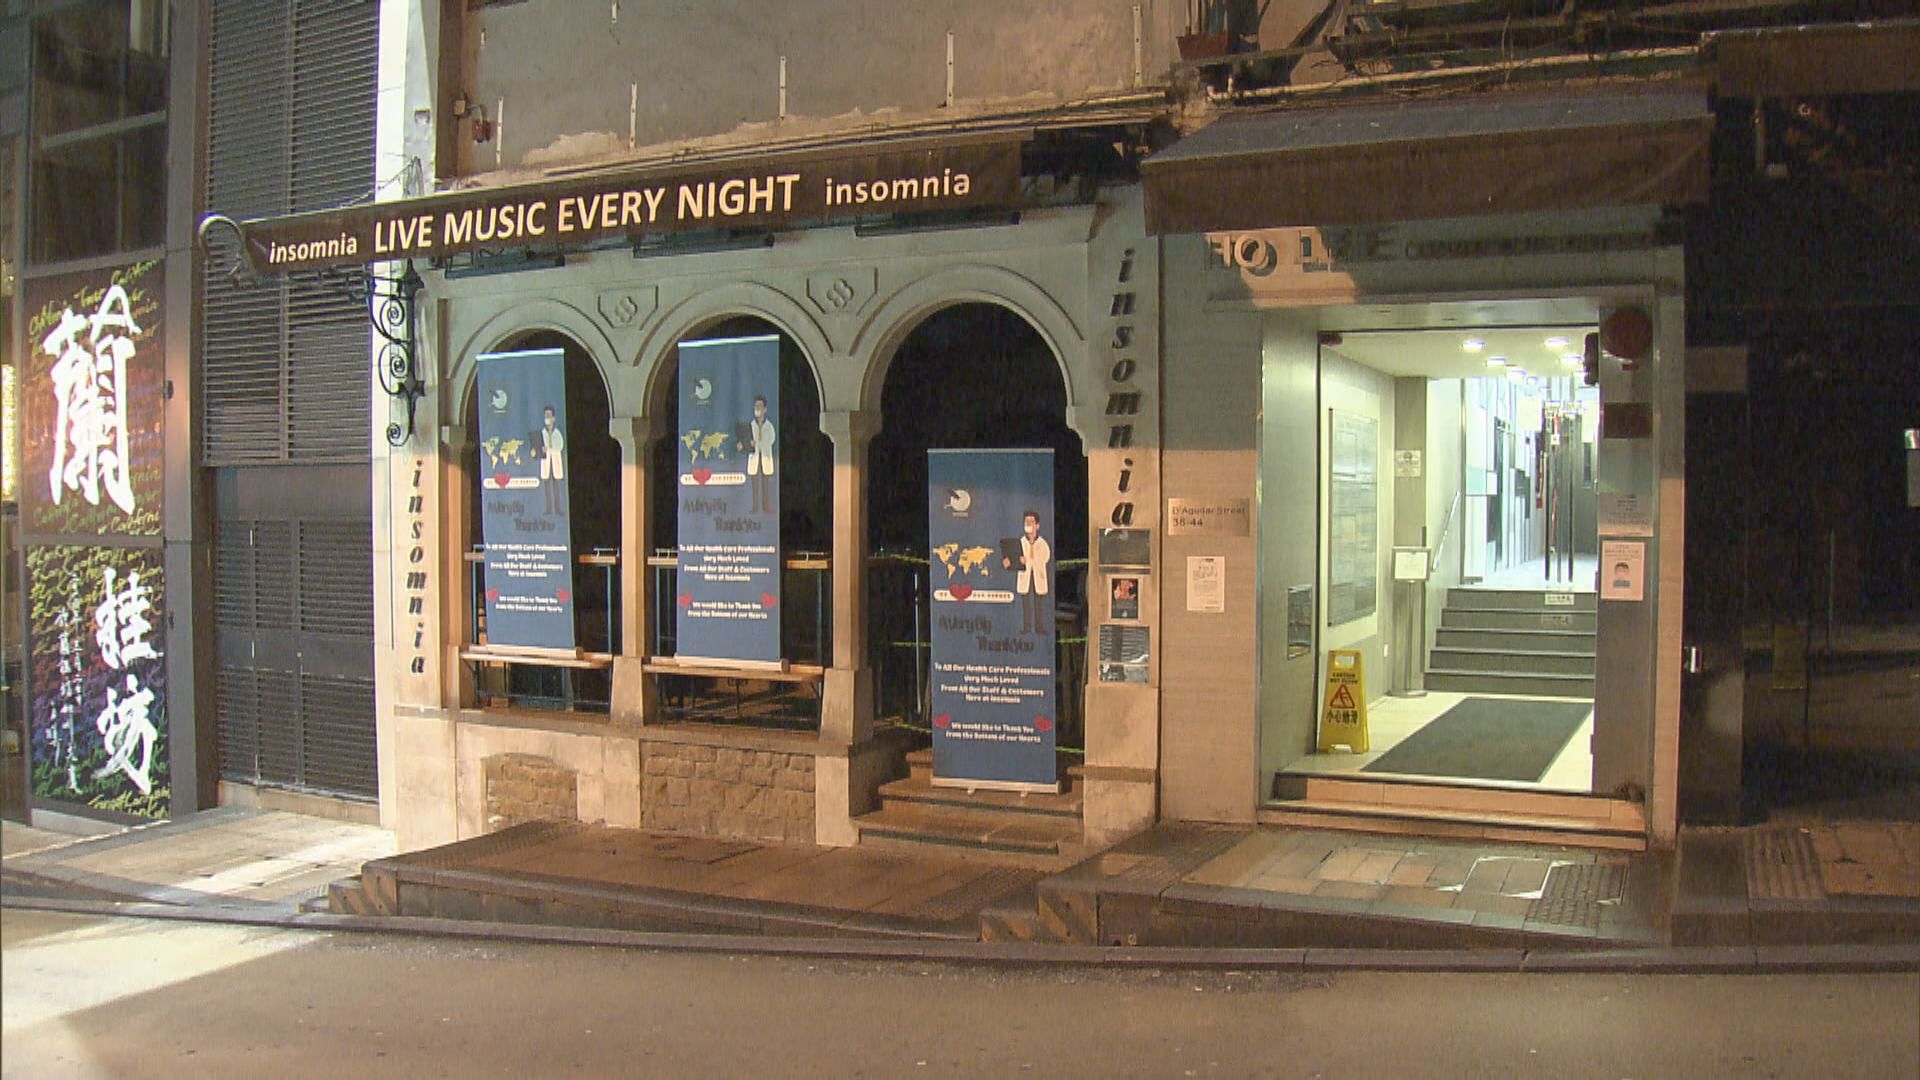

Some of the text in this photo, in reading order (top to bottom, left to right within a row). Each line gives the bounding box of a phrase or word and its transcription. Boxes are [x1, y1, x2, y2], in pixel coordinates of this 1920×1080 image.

[269, 168, 970, 264] insomnia LIVE MUSIC EVERY NIGHT insomnia
[1105, 247, 1140, 527] insomnia
[407, 460, 427, 674] insomnia
